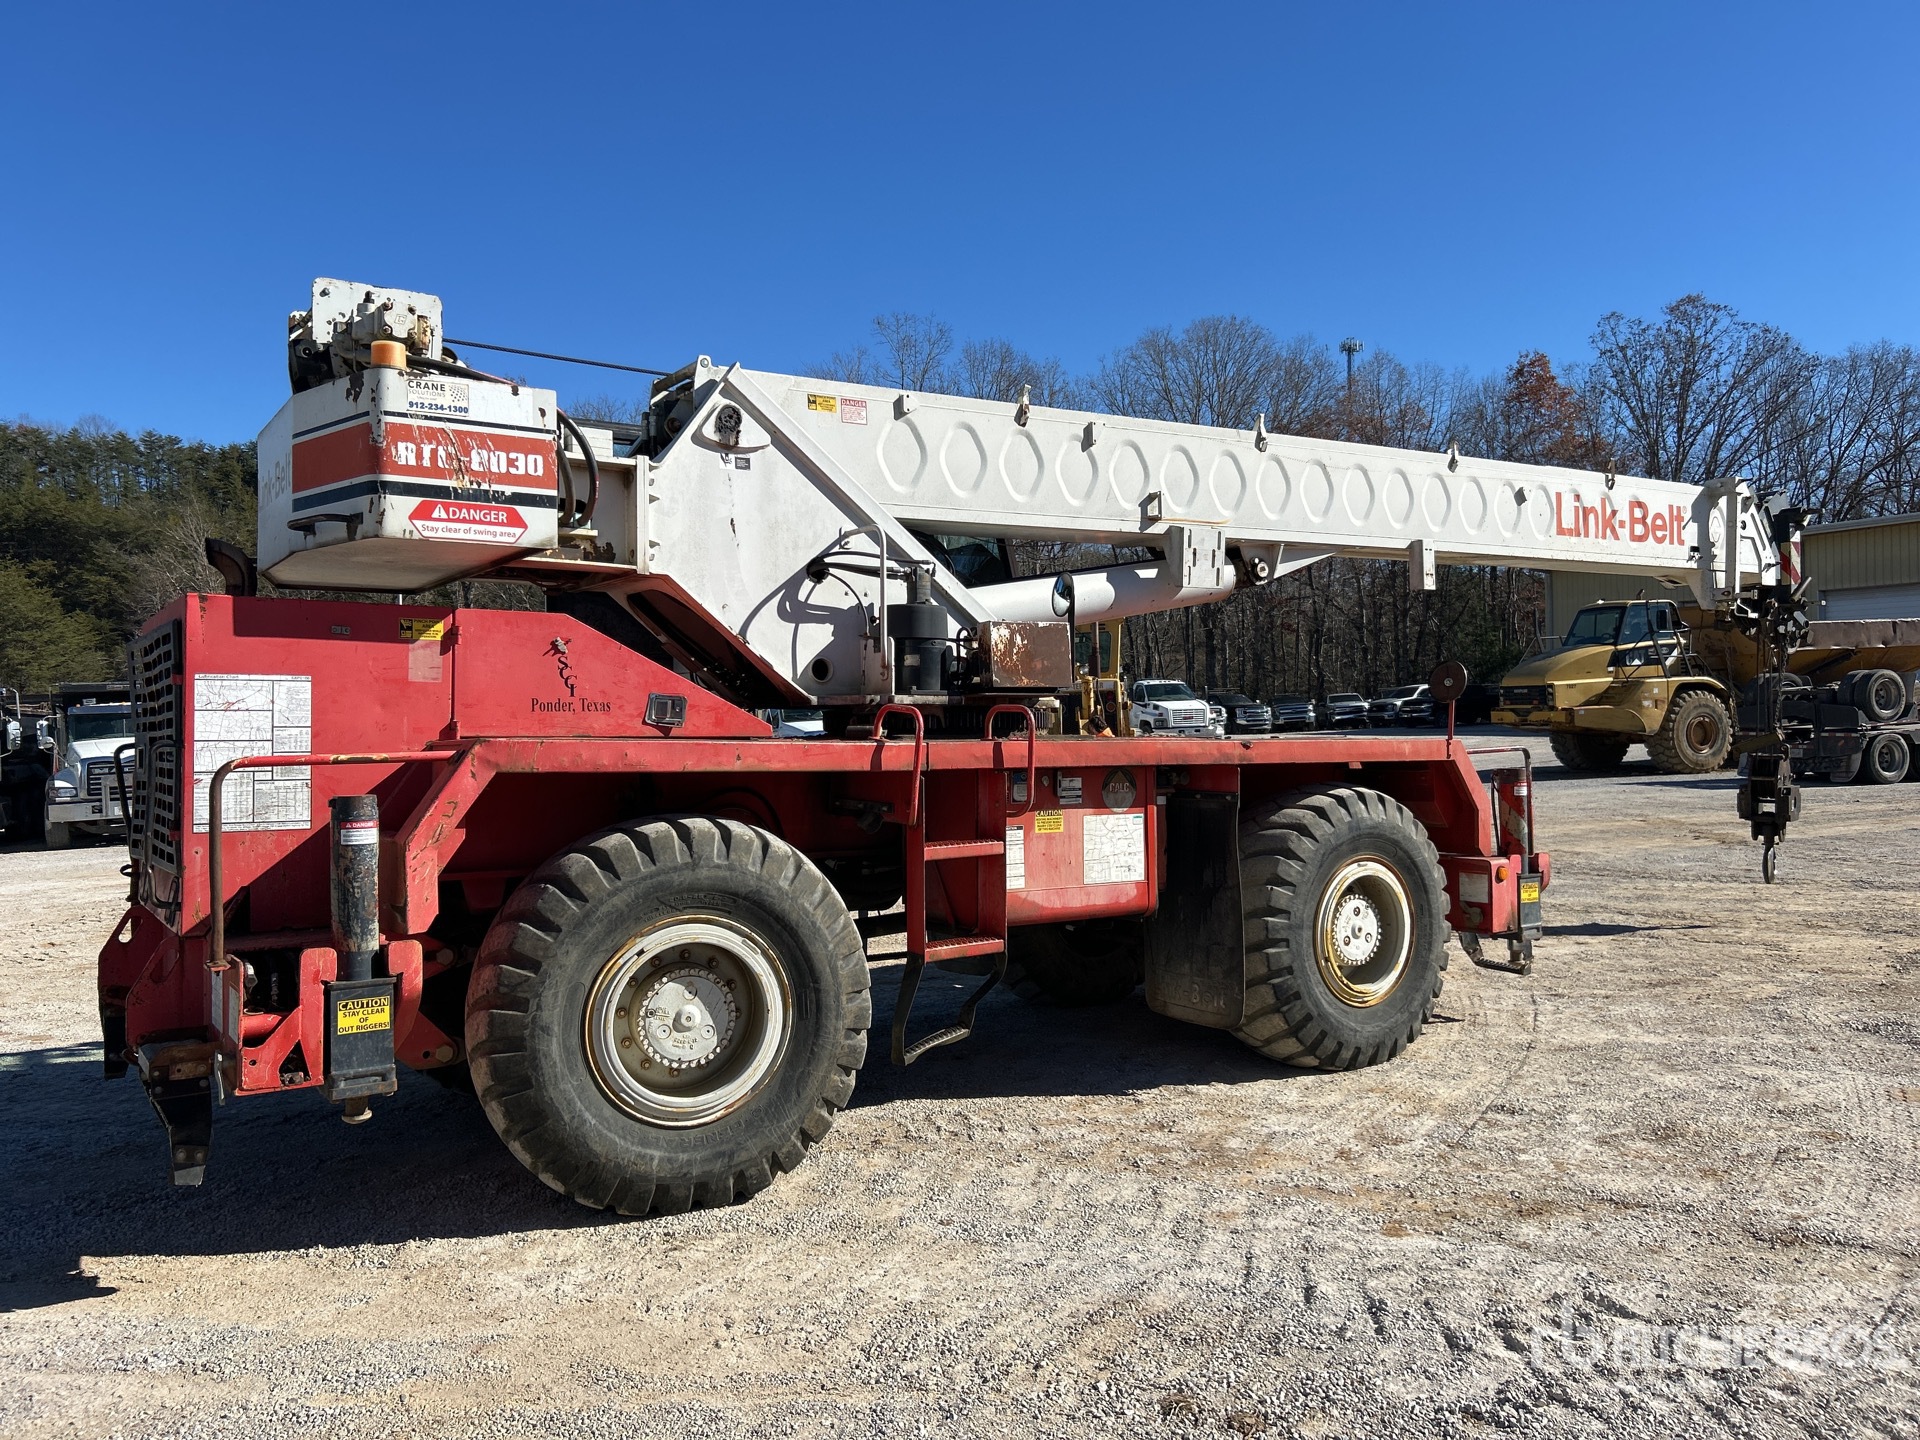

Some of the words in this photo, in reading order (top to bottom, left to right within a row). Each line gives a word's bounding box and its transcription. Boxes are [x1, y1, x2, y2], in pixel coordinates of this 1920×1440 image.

[407, 380, 446, 392] CRANE
[408, 388, 446, 398] SOLUTIONS
[408, 400, 469, 414] 912-234-1300
[449, 506, 508, 524] DANGER
[1555, 491, 1685, 546] Link-Belt
[421, 523, 439, 533] Stay
[441, 525, 462, 534] clear
[463, 526, 473, 535] of
[473, 528, 498, 538] swing
[499, 531, 517, 539] area
[531, 698, 576, 714] Ponder,
[579, 698, 611, 712] Texas
[339, 998, 388, 1010] CAUTION
[342, 1010, 360, 1018] STAY
[361, 1007, 385, 1016] CLEAR
[338, 1026, 355, 1034] OUT
[355, 1021, 390, 1032] RIGGERS!
